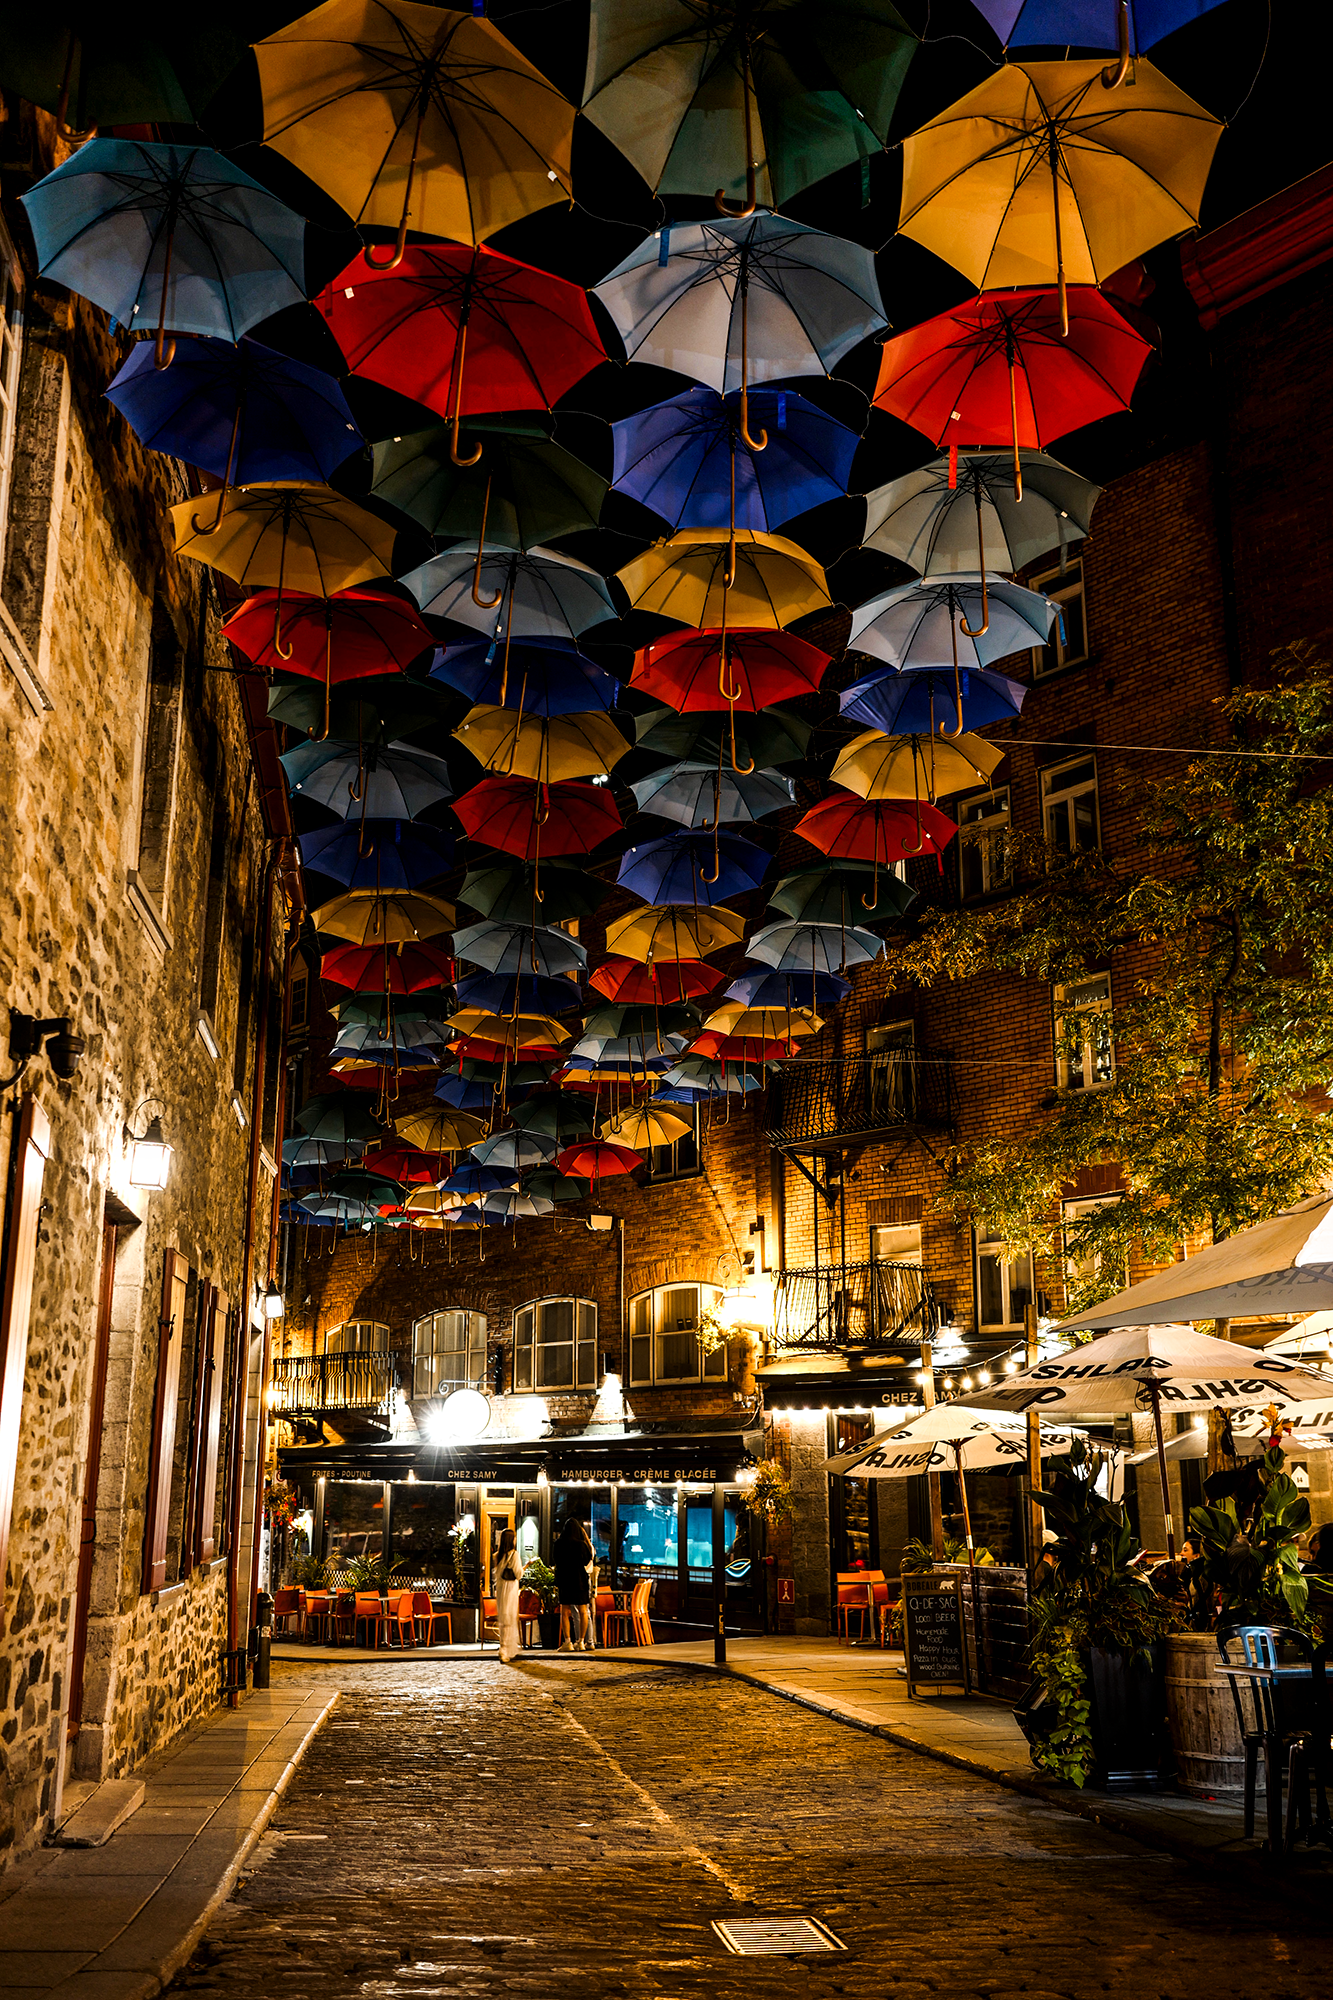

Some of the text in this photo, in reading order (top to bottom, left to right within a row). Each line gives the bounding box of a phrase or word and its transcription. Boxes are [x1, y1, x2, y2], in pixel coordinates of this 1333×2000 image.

[881, 1392, 918, 1403] CHEZ
[312, 1470, 335, 1478] FRITES
[341, 1470, 372, 1478] POUTINE
[448, 1470, 498, 1479] CHEZ SAMY
[561, 1469, 623, 1479] HAMBURGER
[634, 1468, 670, 1479] CRÈME
[674, 1468, 717, 1479] GLACÉE
[935, 1612, 957, 1623] BEER
